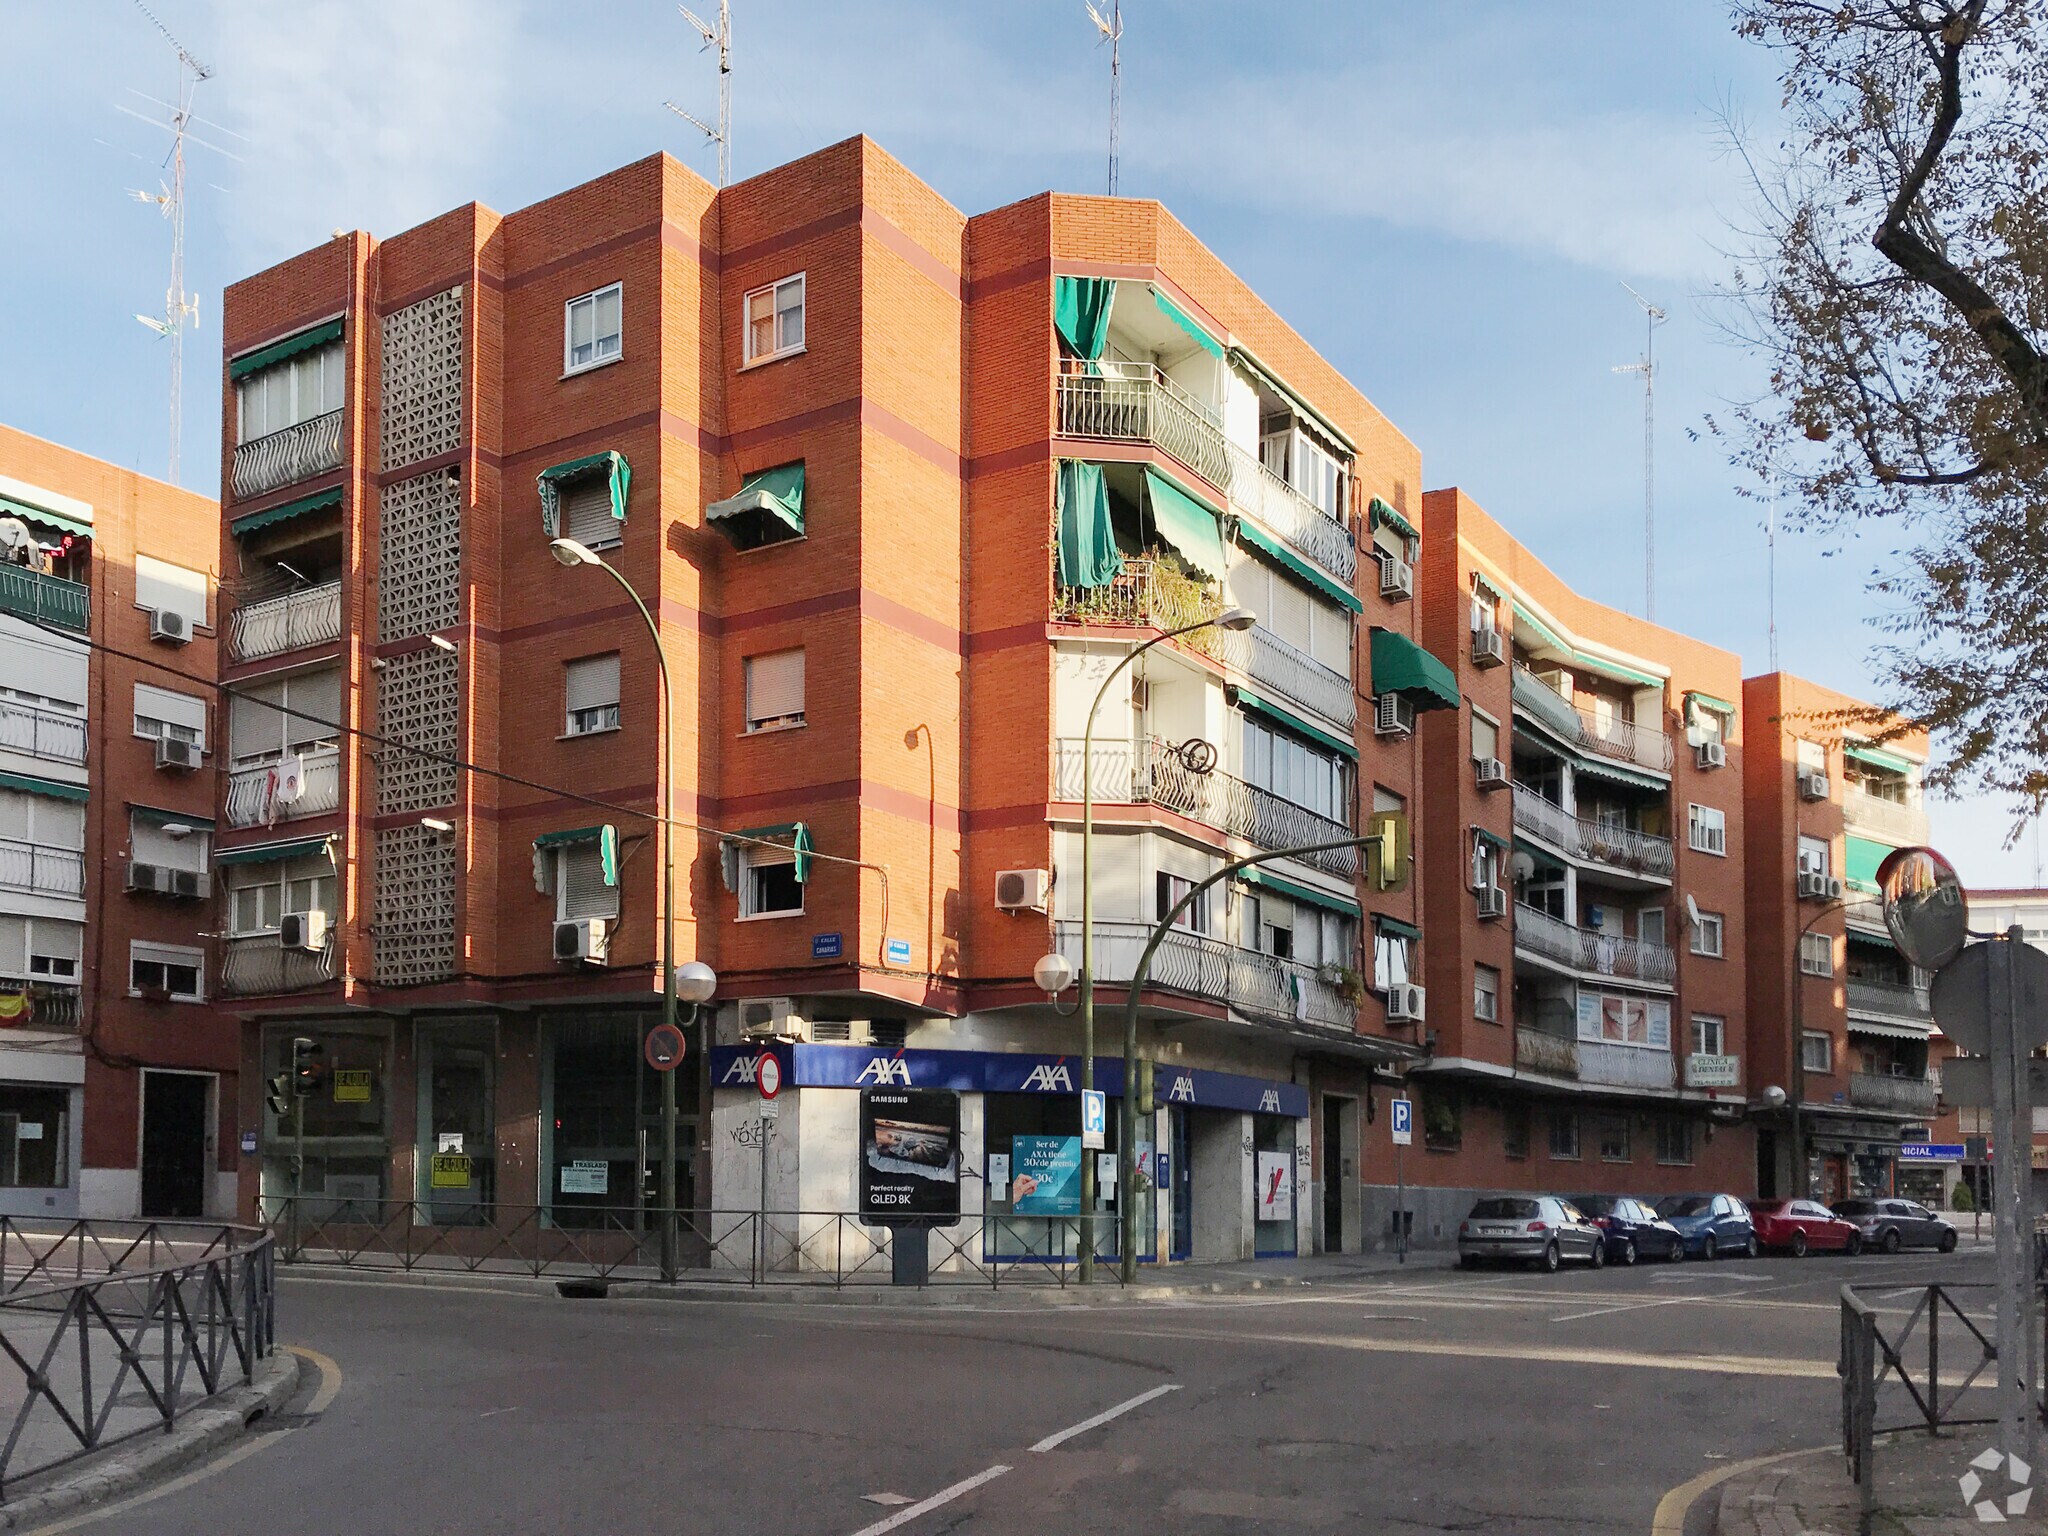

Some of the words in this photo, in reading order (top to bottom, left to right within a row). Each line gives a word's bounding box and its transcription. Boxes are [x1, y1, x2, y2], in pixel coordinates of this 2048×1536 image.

[816, 946, 837, 954] CANARIAS
[854, 1057, 912, 1086] AXA
[337, 1073, 345, 1086] SE
[1020, 1065, 1073, 1092] AXA
[1169, 1076, 1195, 1102] AXA
[870, 1095, 908, 1104] SAMSUNG
[1258, 1089, 1281, 1113] AXA
[1088, 1096, 1101, 1129] P
[1396, 1104, 1408, 1129] P
[434, 1158, 442, 1171] SE
[443, 1158, 468, 1171] ALQUILA
[1040, 1159, 1049, 1167] de
[894, 1185, 914, 1193] reality
[870, 1194, 897, 1204] QLED
[898, 1194, 911, 1204] 8K
